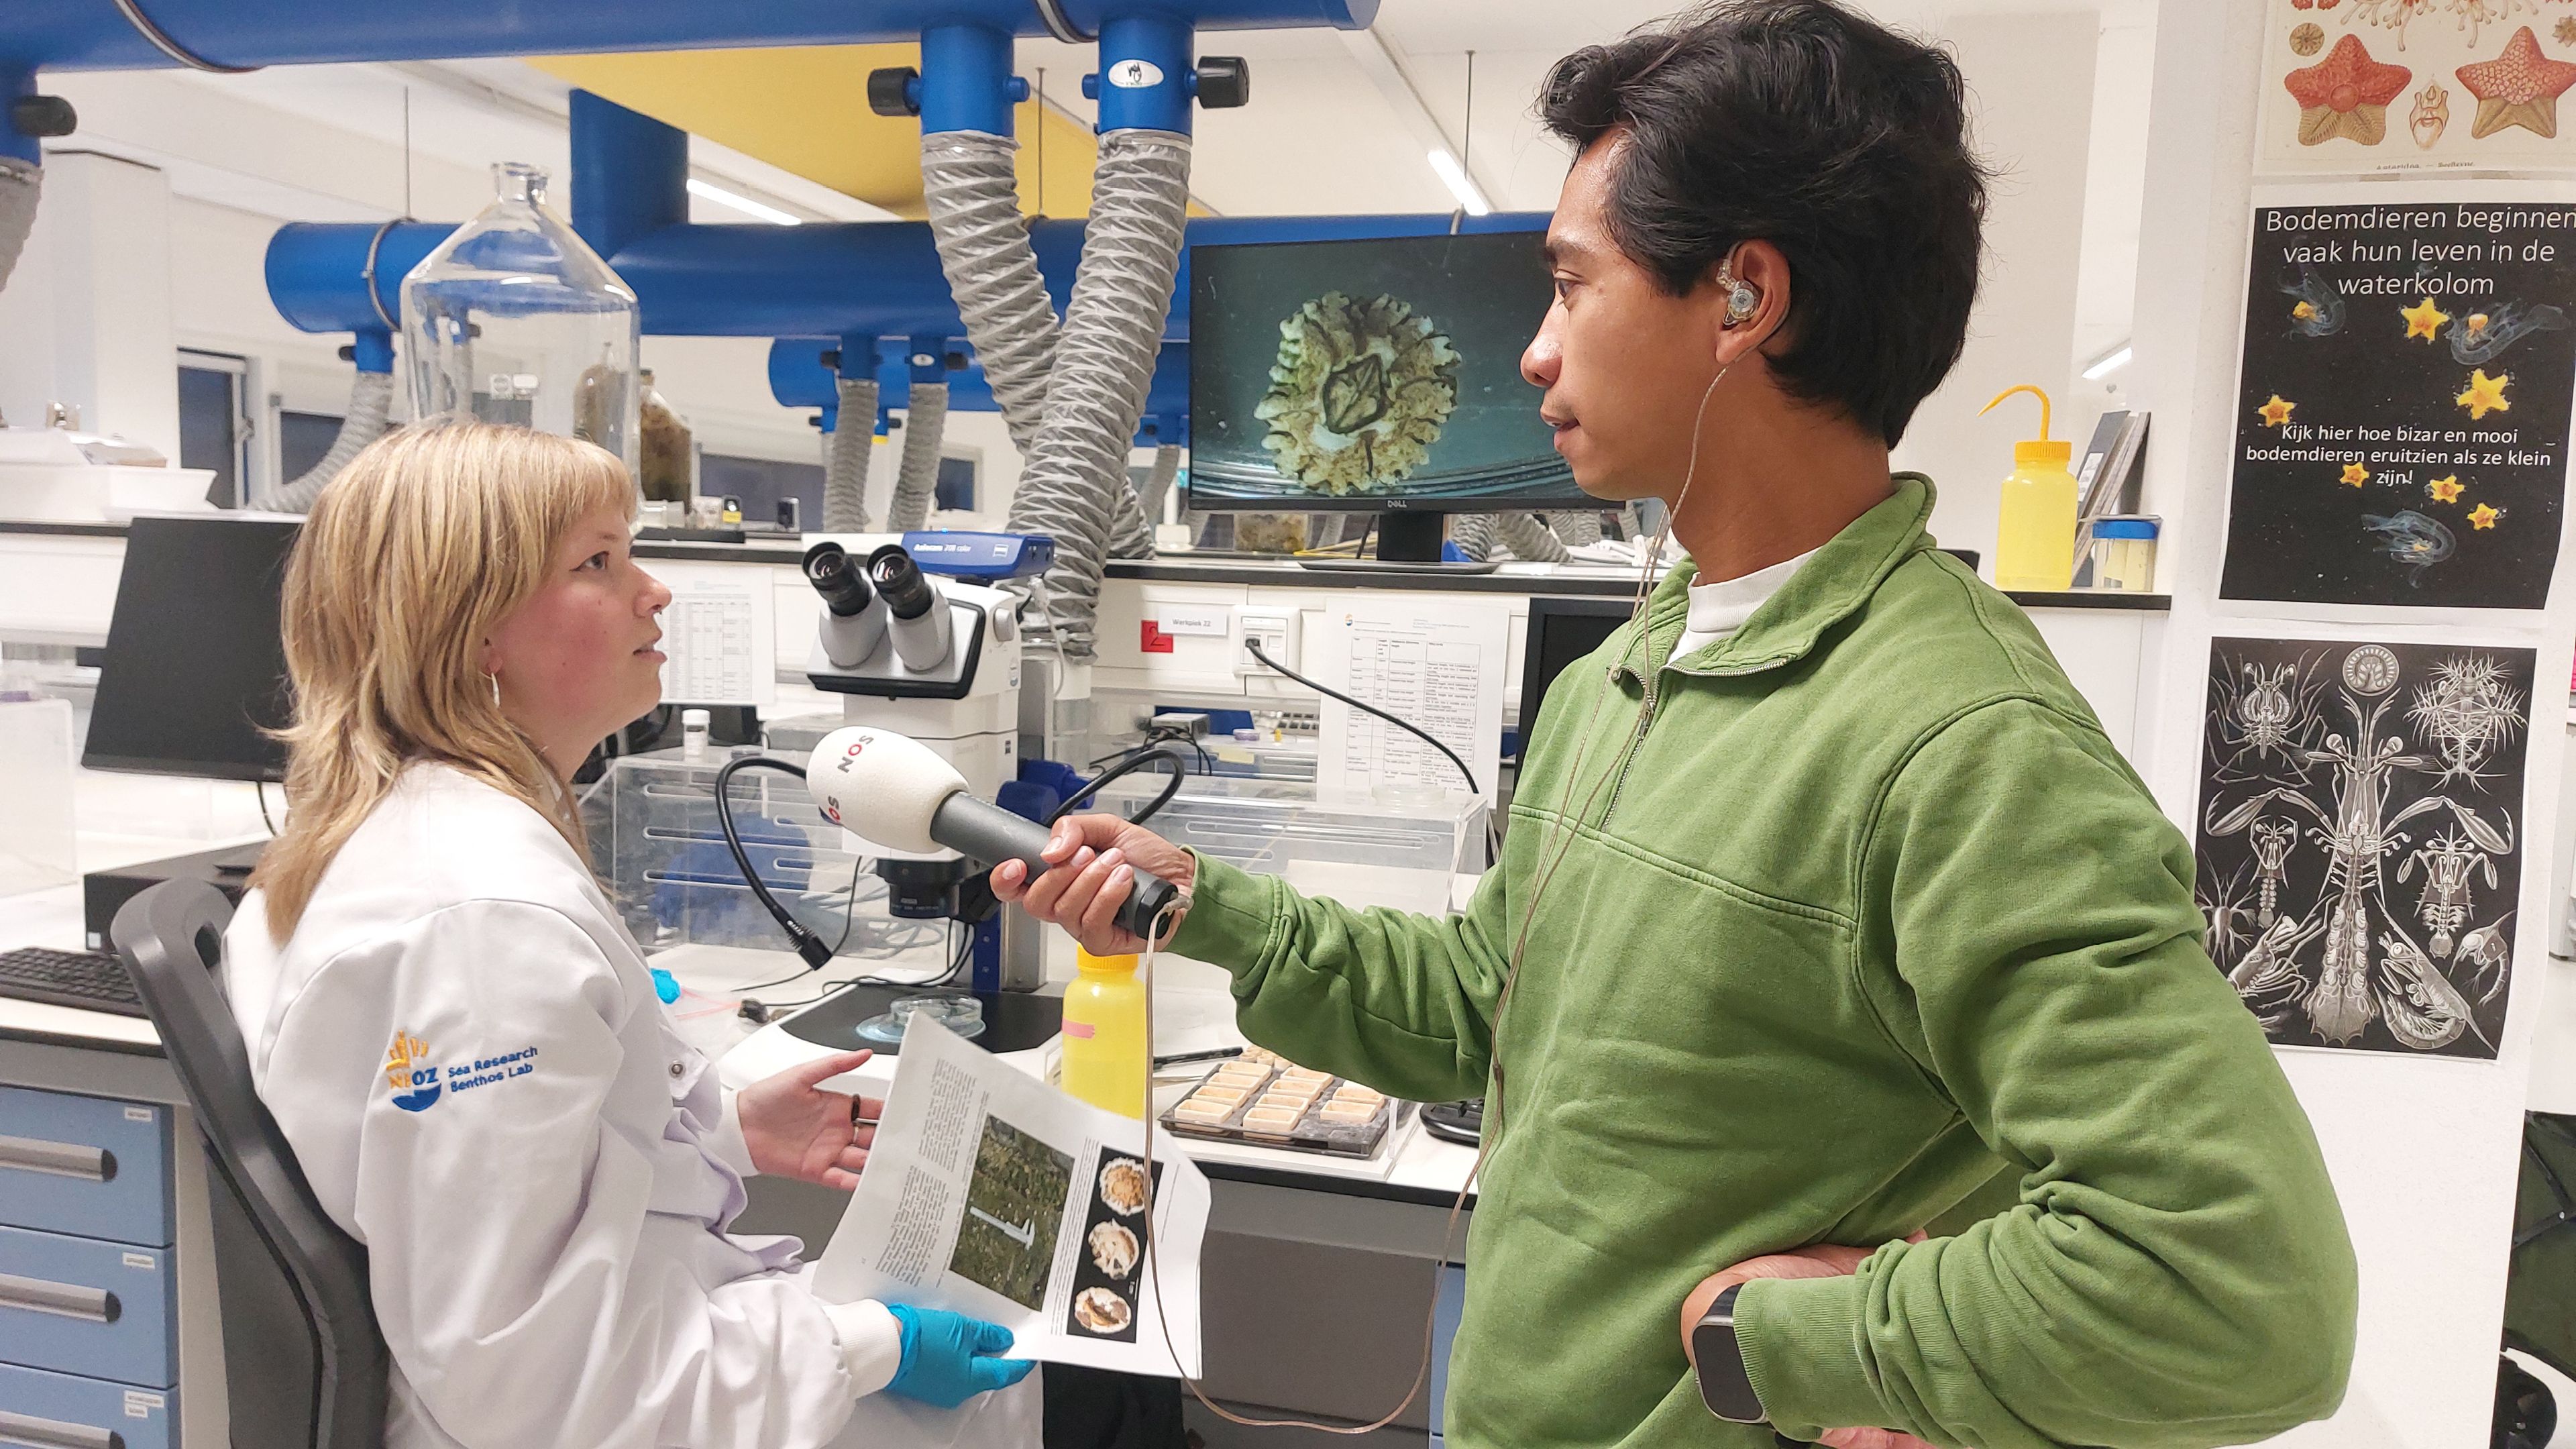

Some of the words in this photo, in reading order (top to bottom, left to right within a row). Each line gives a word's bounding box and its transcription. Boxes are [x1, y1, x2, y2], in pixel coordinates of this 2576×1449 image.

[2266, 207, 2447, 231] Bodemdieren
[2457, 205, 2576, 233] beginnen
[2284, 239, 2343, 263] vaak
[2352, 239, 2402, 262] hun
[2412, 239, 2481, 262] leven
[2491, 239, 2513, 262] in
[2522, 239, 2555, 262] de
[2338, 270, 2494, 294] waterkolom
[2282, 425, 2312, 443] Kijk
[2318, 425, 2354, 441] hier
[2358, 426, 2392, 441] hoe
[2396, 427, 2440, 443] bizar
[2444, 430, 2466, 443] en
[2471, 429, 2518, 443] mooi
[2246, 445, 2365, 463] bodemdieren
[2371, 447, 2449, 464] eruitzien
[2453, 448, 2477, 465] als
[2482, 453, 2502, 466] ze
[2507, 449, 2551, 466] klein
[2375, 470, 2413, 487] zijn!
[1387, 500, 1407, 508] DELL
[837, 735, 874, 773] NOS
[828, 795, 841, 820] OS
[448, 1065, 471, 1078] Sea
[474, 1046, 538, 1071] Research
[450, 1071, 504, 1093] Benthos
[508, 1063, 533, 1077] Lab
